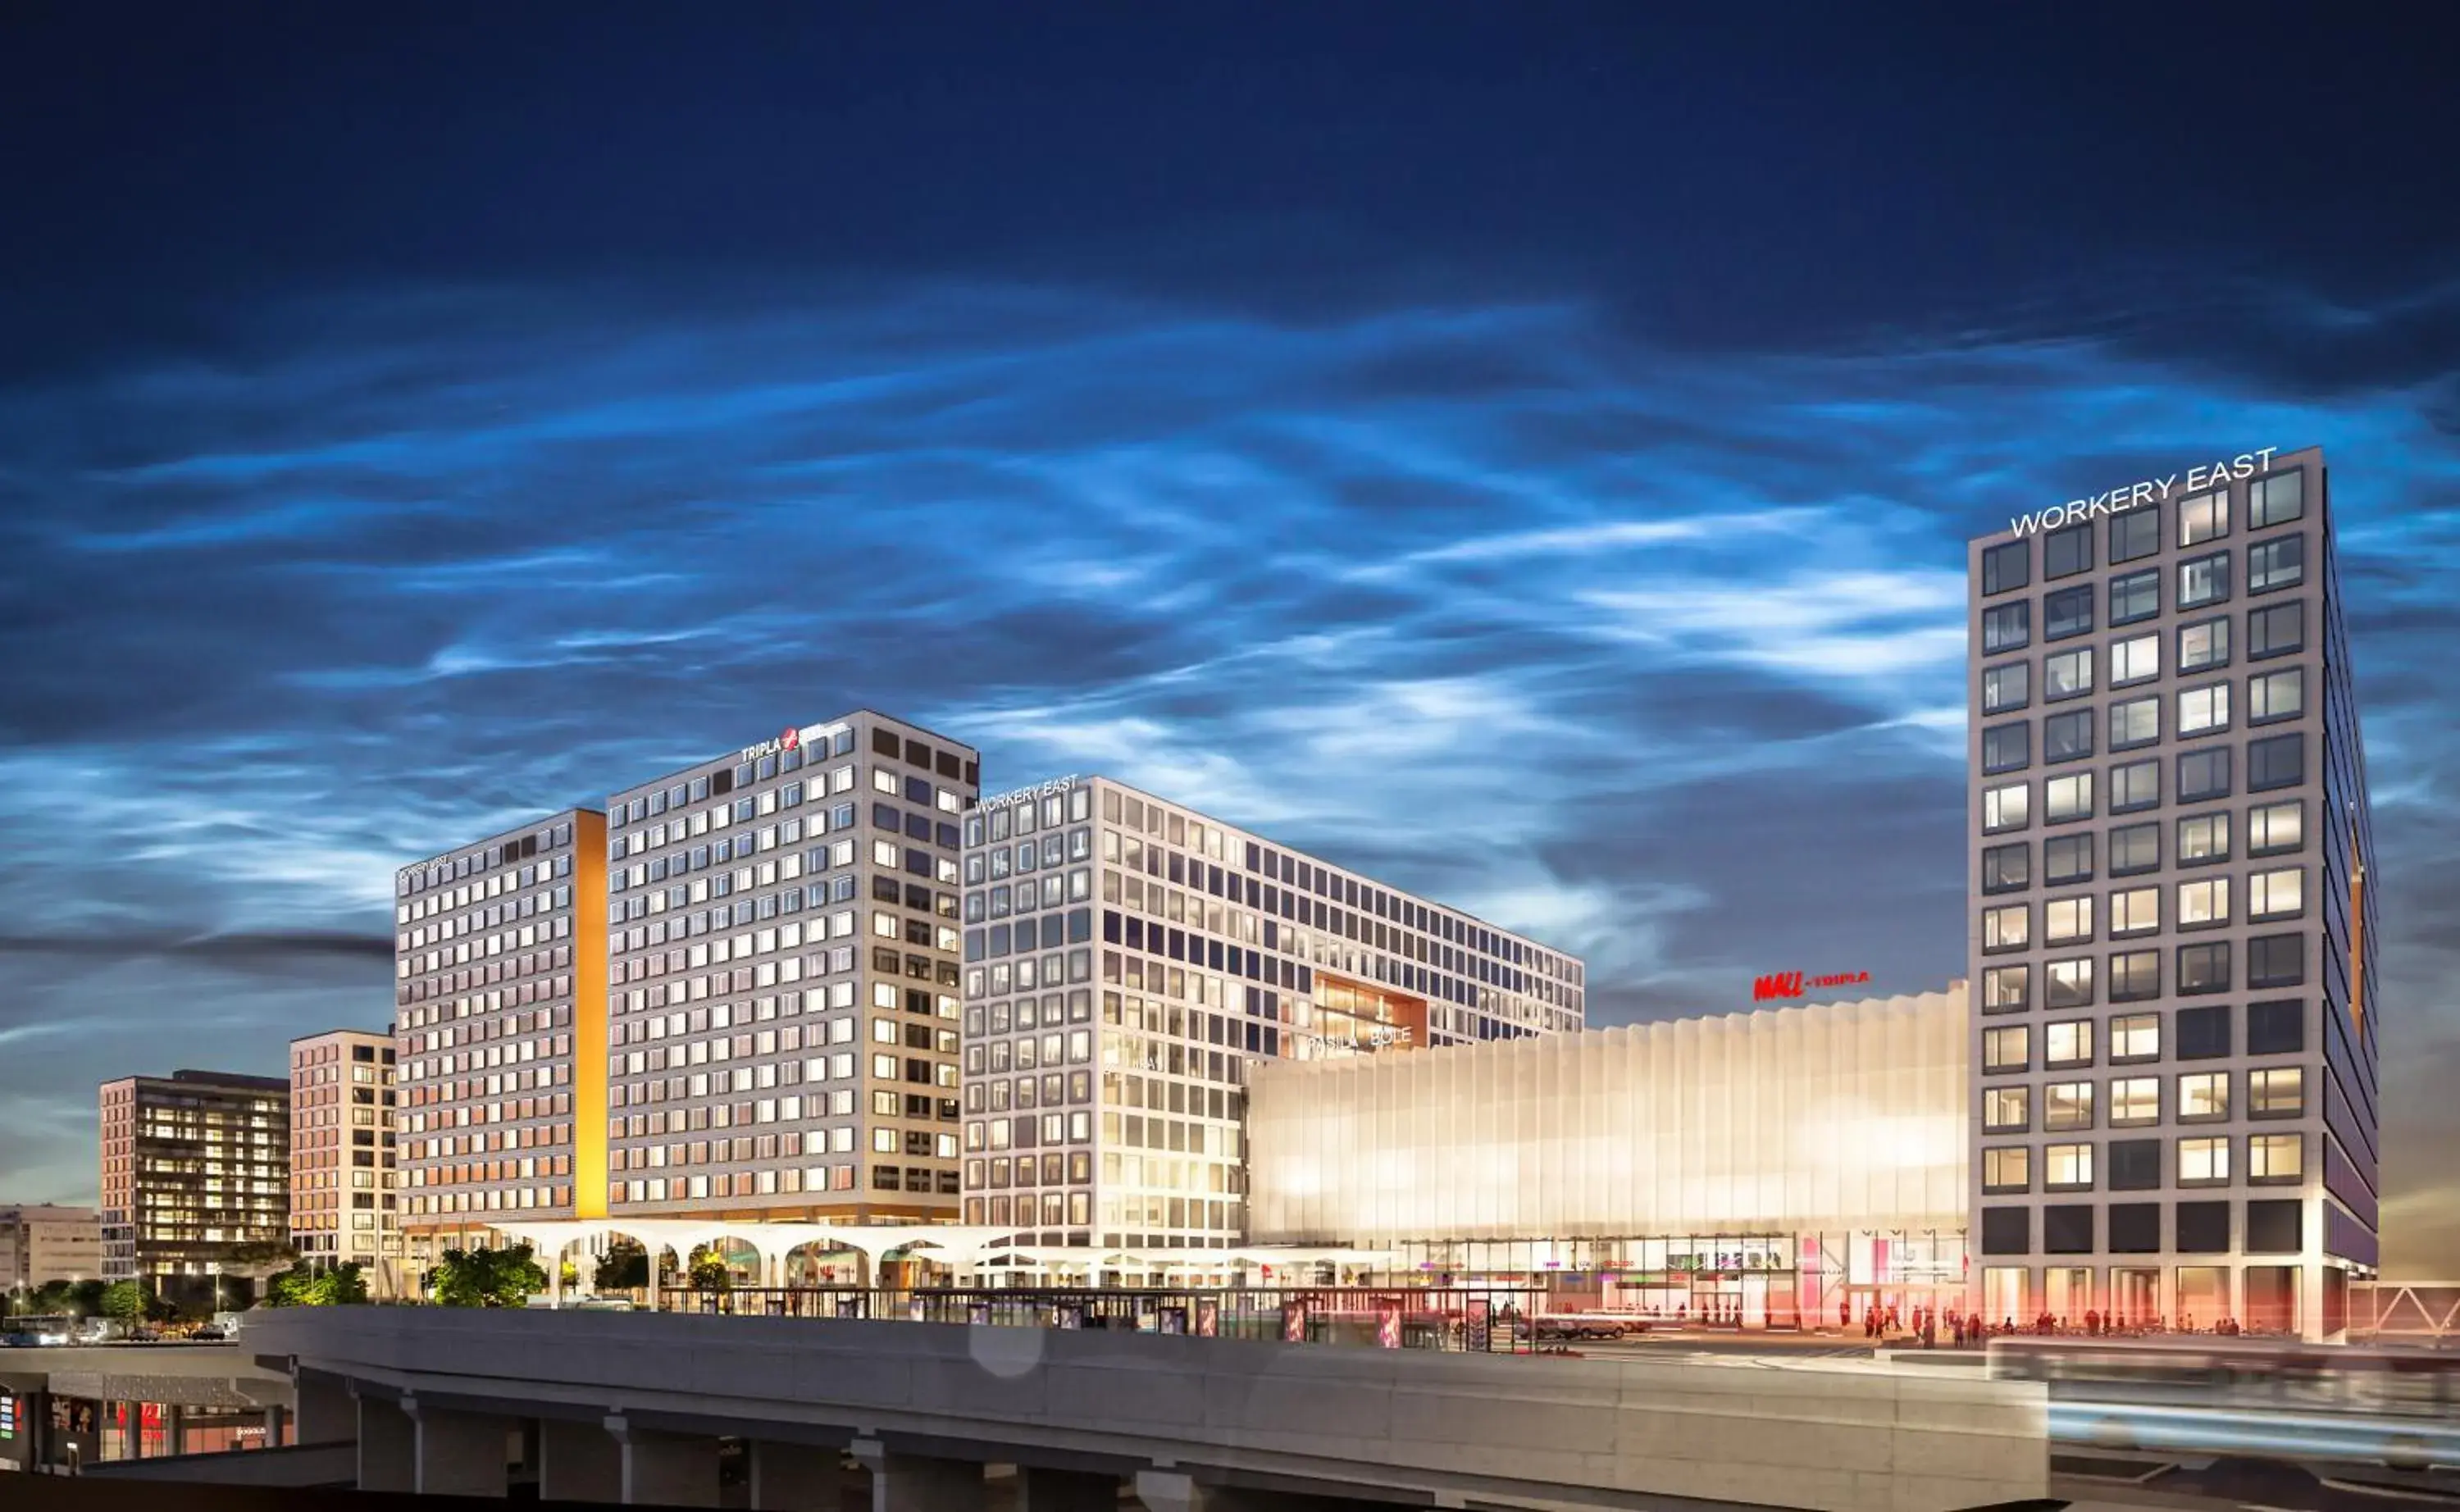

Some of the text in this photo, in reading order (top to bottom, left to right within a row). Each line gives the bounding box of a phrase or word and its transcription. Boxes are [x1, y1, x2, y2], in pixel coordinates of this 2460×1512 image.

[2010, 446, 2277, 538] WORKERY EAST
[741, 736, 781, 763] TRIPLA
[975, 773, 1079, 814] WORKERY EAST
